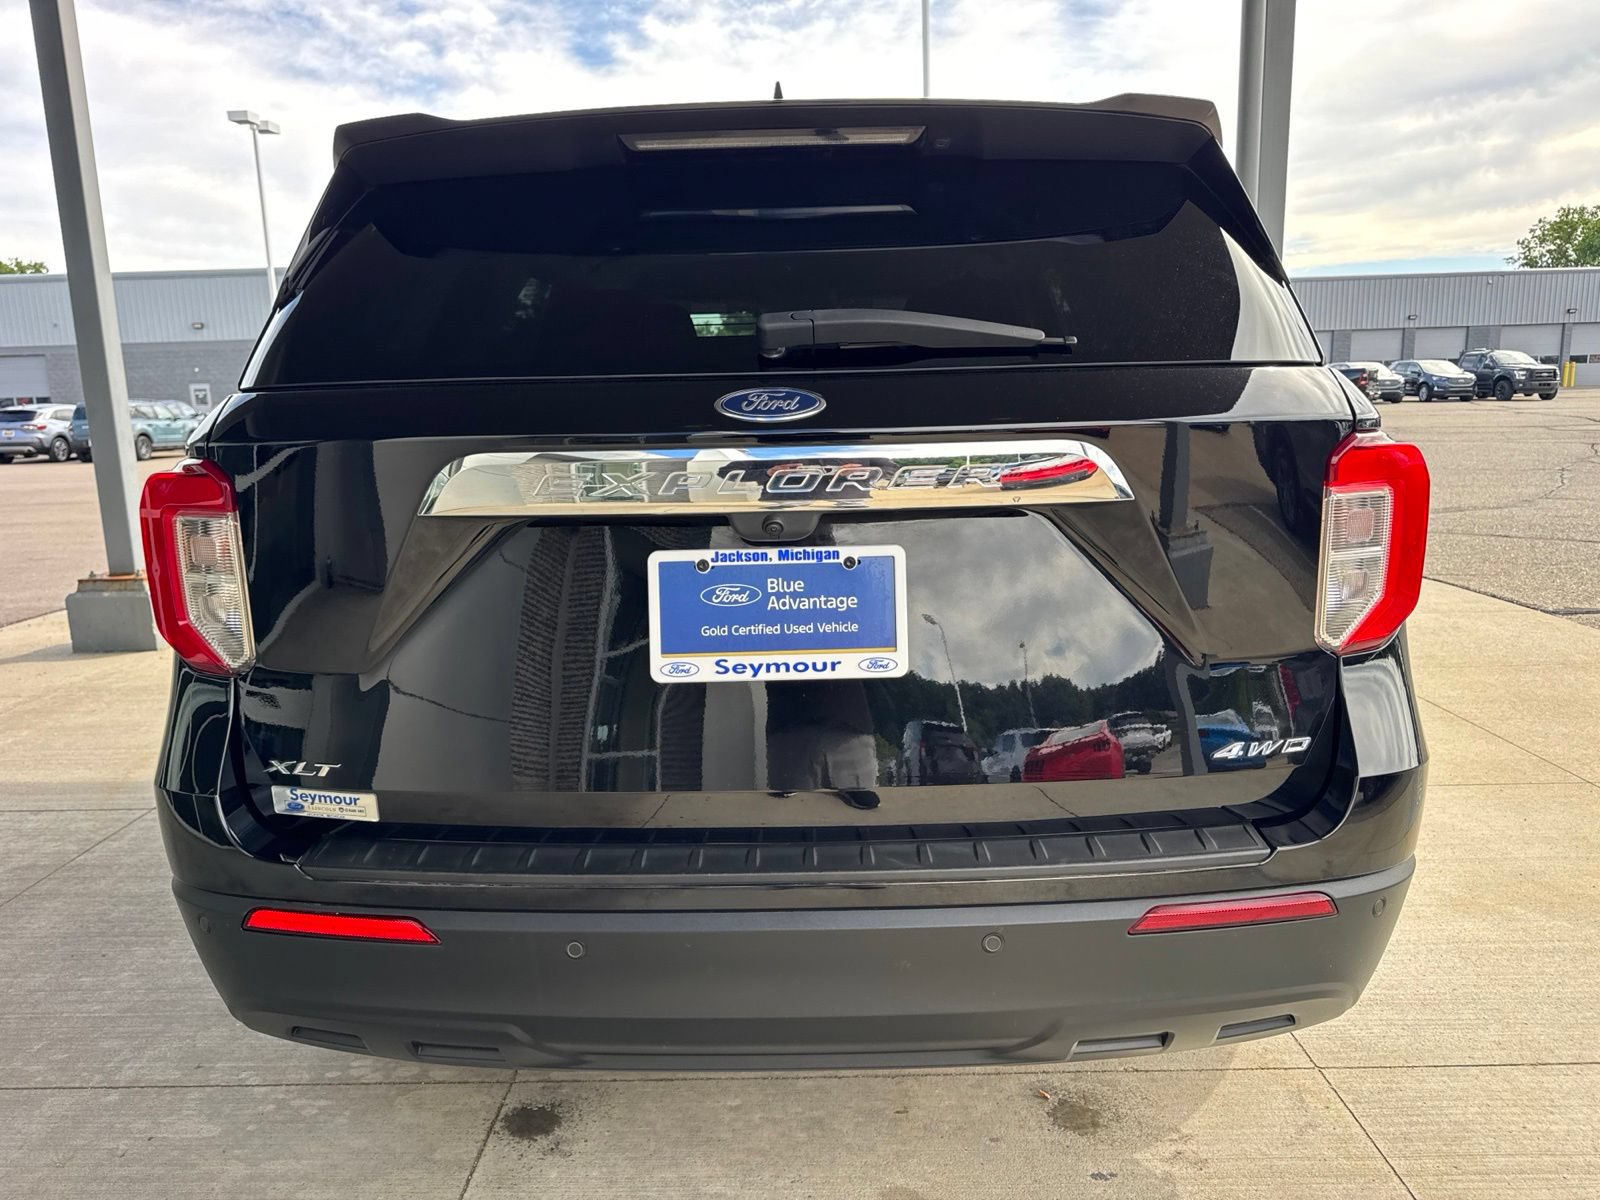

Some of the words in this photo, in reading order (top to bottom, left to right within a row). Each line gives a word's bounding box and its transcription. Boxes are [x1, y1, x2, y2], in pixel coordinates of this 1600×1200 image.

[741, 392, 800, 411] Ford
[533, 465, 1003, 496] EXPLORER
[710, 550, 773, 563] Jackson,
[777, 548, 840, 562] Michigan
[767, 577, 804, 593] Blue
[711, 586, 750, 603] Ford
[767, 594, 858, 611] Advantage
[701, 625, 728, 637] Gold
[731, 623, 780, 636] Certified
[784, 622, 814, 634] Used
[817, 621, 859, 633] Vehicle
[668, 664, 692, 675] Ford
[714, 659, 842, 678] Seymour
[866, 659, 890, 670] Ford
[1210, 737, 1311, 759] 4WD
[263, 760, 341, 777] XLT
[290, 787, 360, 805] Seymour
